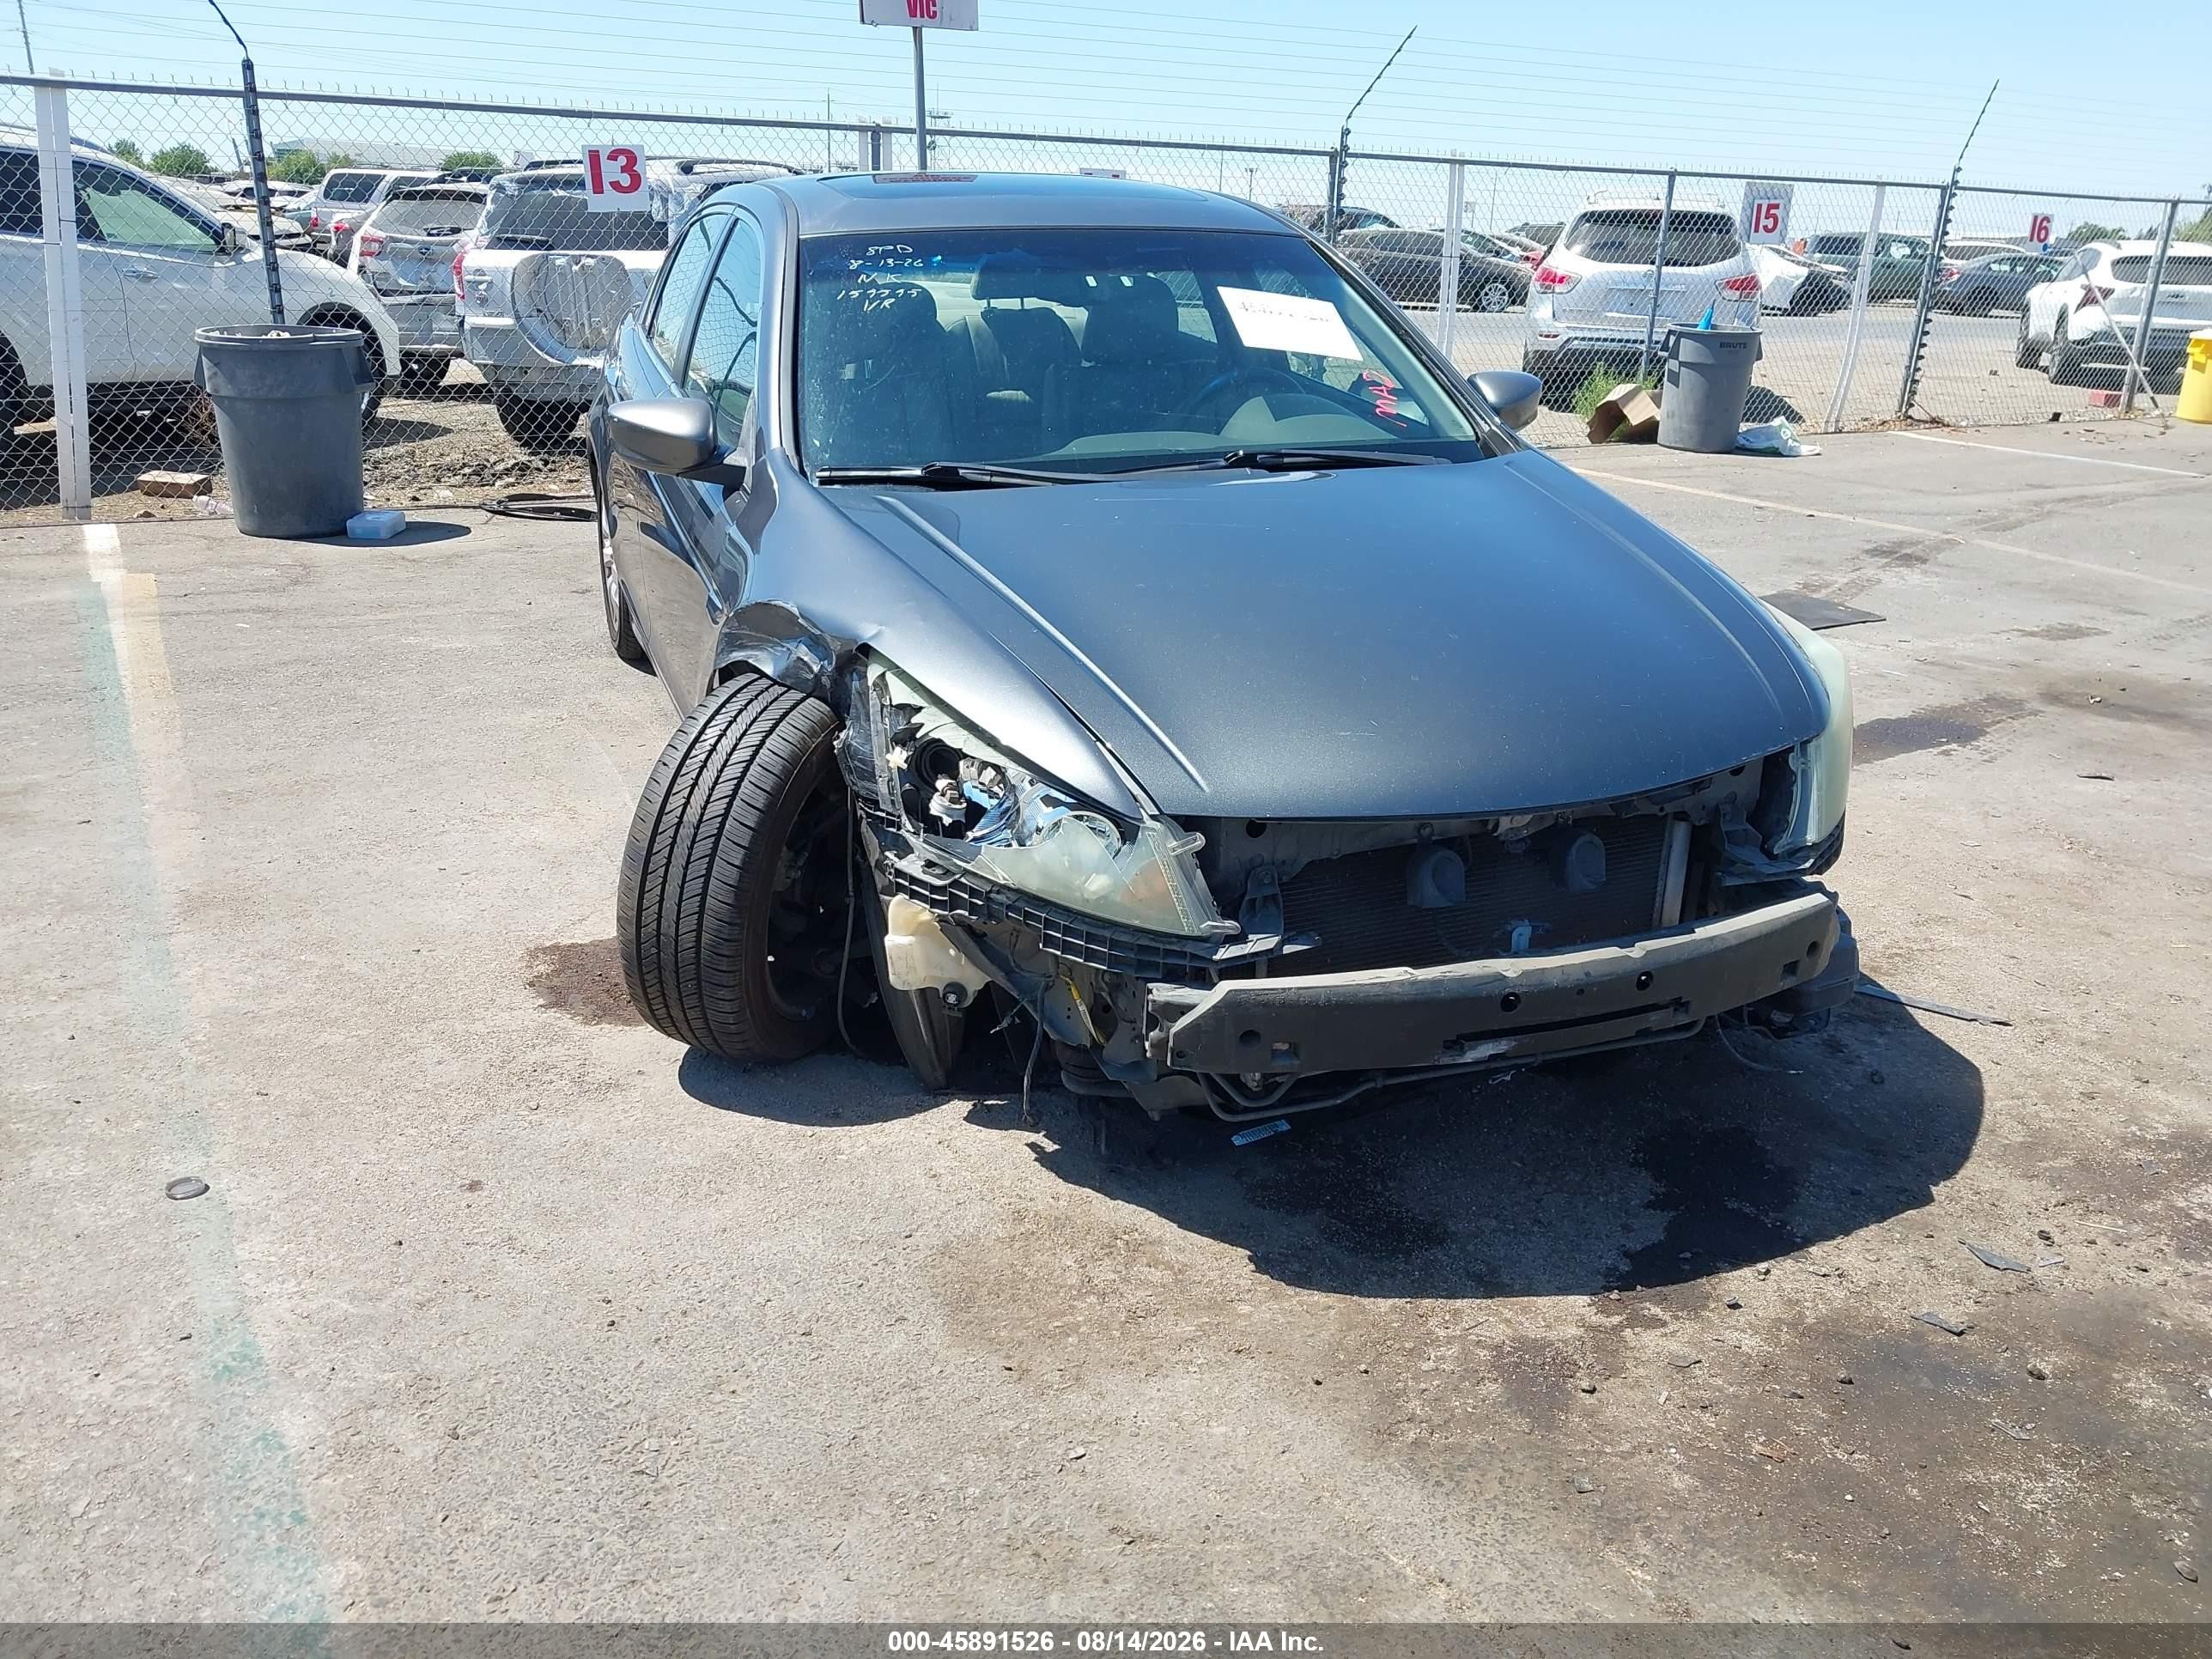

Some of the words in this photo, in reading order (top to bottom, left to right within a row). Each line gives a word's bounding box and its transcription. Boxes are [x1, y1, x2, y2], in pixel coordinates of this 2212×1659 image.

[588, 148, 642, 195] 13
[1753, 203, 1780, 234] 15
[2029, 216, 2051, 243] 16
